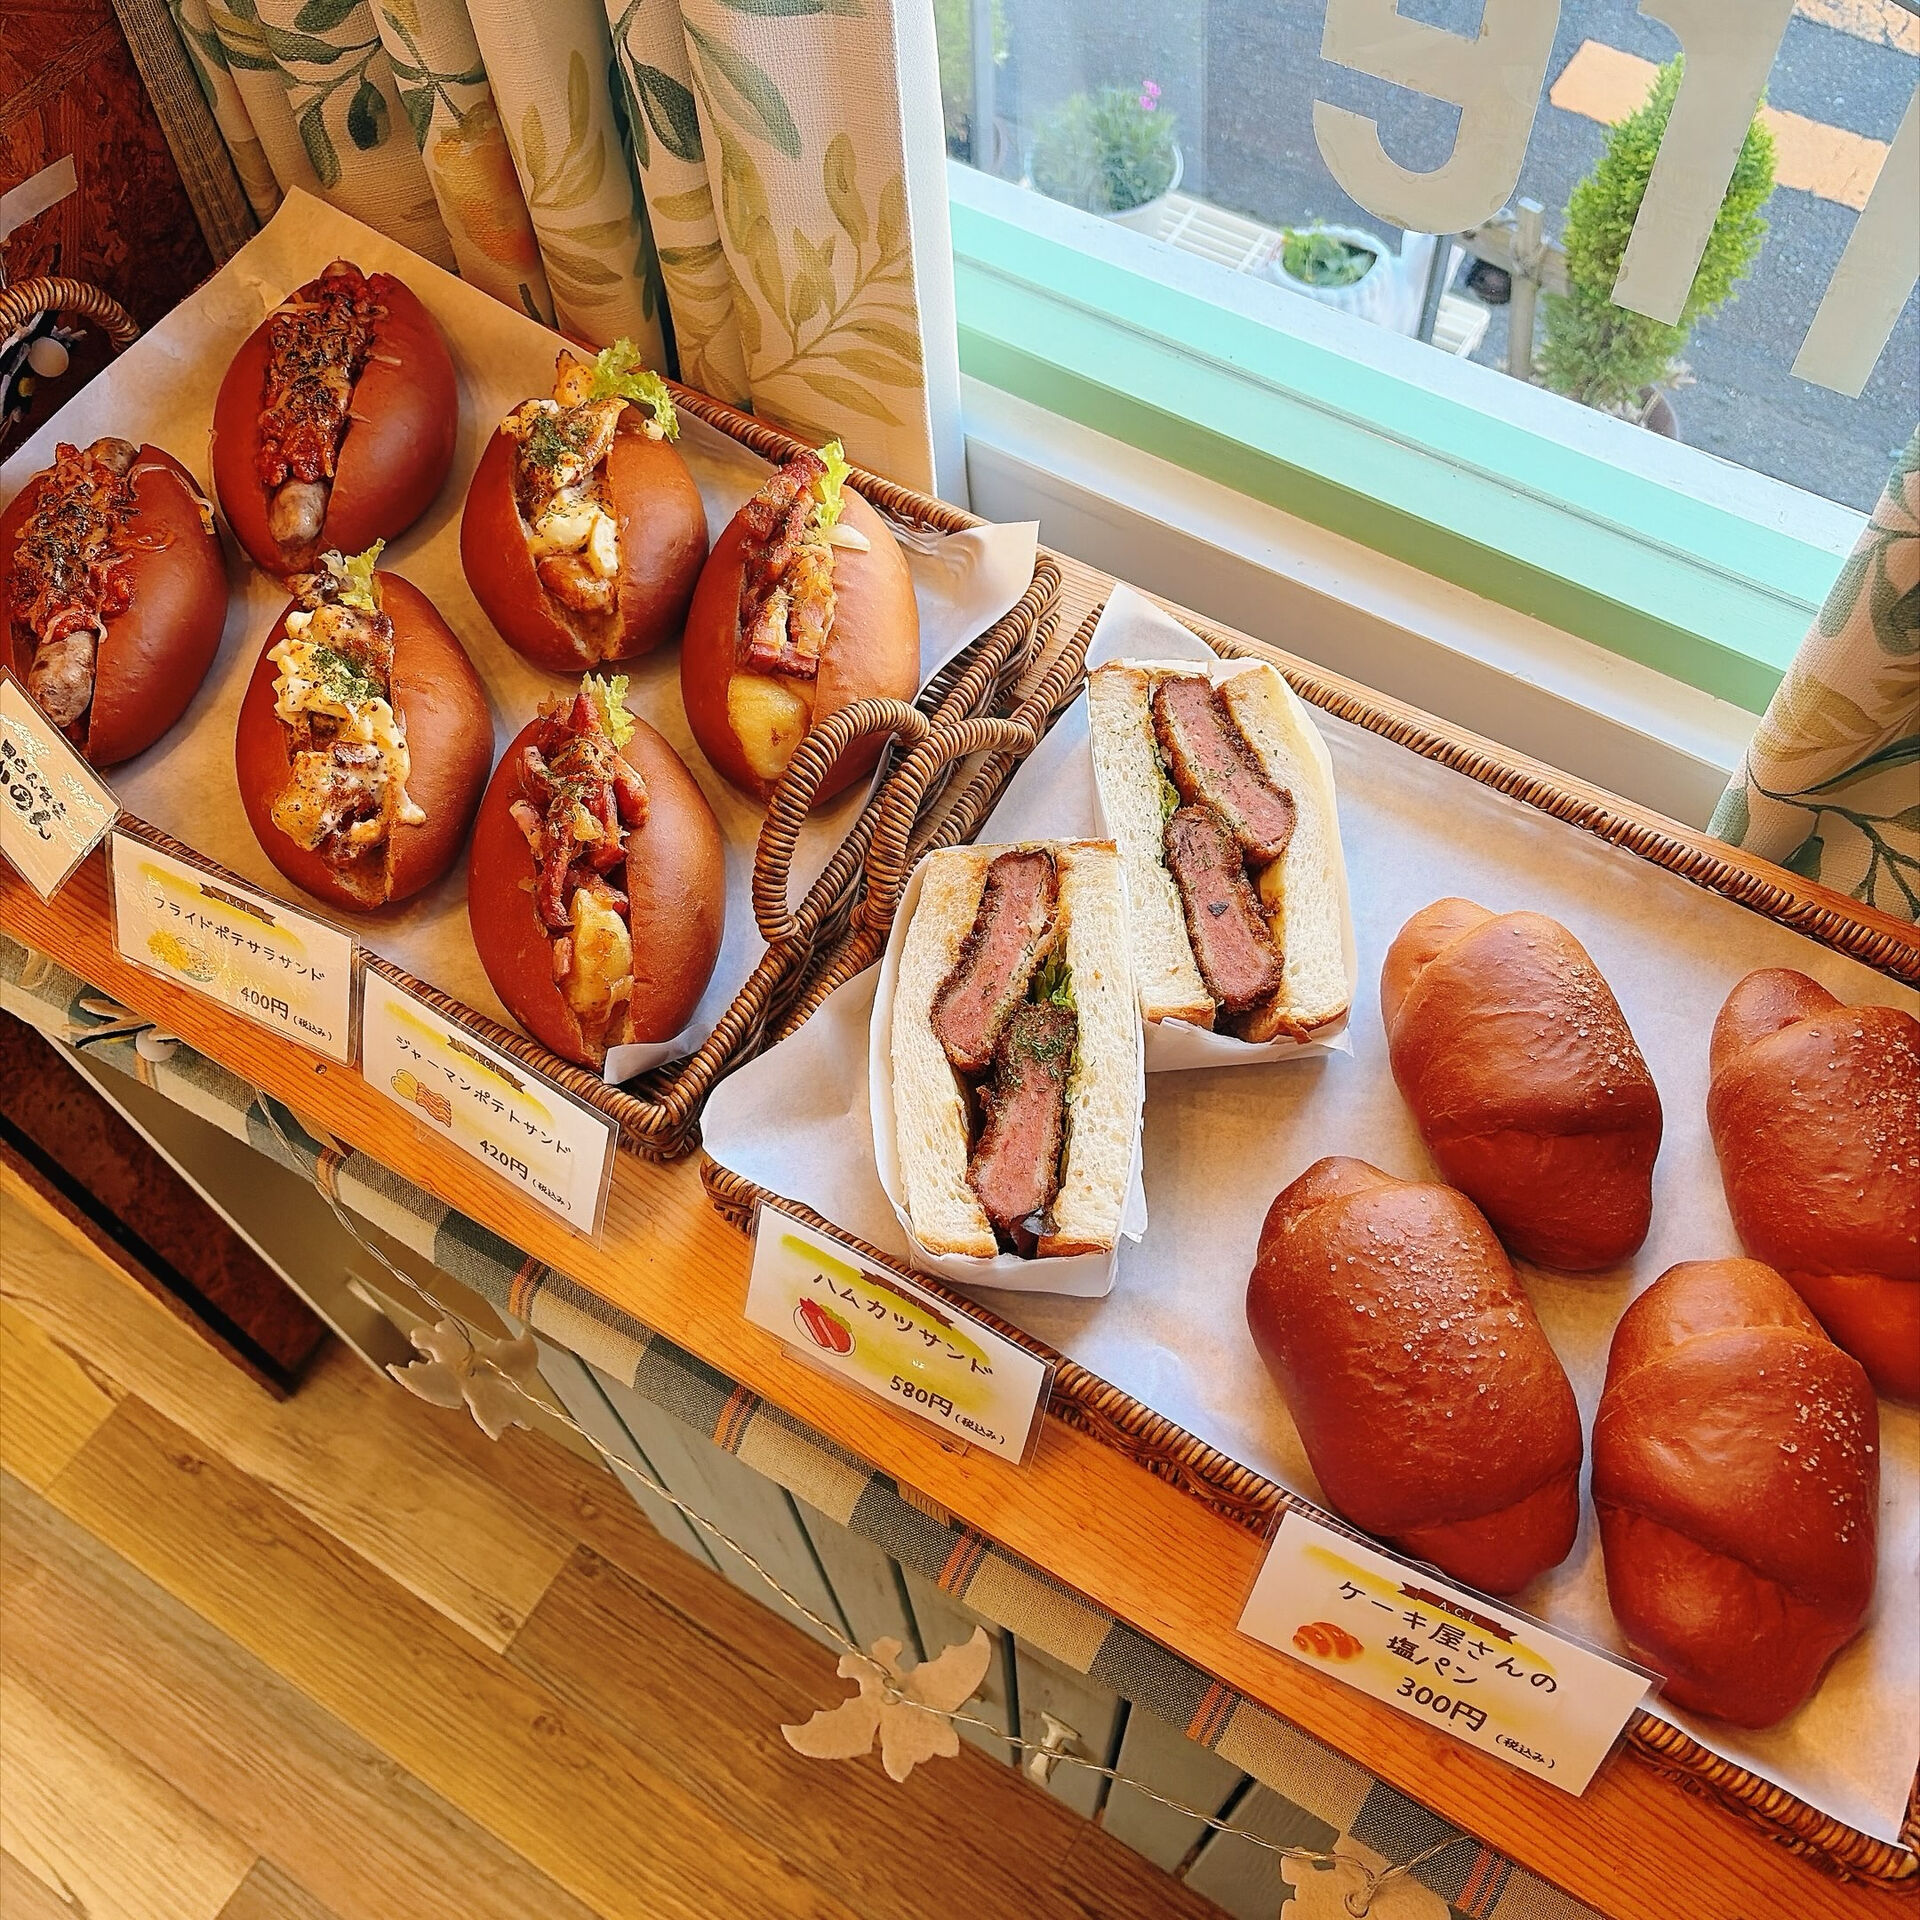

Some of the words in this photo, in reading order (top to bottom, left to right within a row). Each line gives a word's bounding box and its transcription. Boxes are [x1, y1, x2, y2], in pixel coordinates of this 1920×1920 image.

[154, 896, 326, 981] フライドポテサラサンド
[240, 987, 288, 1020] 400円
[396, 1035, 571, 1154] ジャーマンポテトサンド
[479, 1140, 528, 1180] 420円
[813, 1273, 994, 1377] ハムカツサンド
[890, 1375, 953, 1417] 580円
[1338, 1581, 1557, 1694] ケーキ屋さんの
[1386, 1635, 1478, 1685] 塩パン
[1396, 1677, 1487, 1732] 300円
